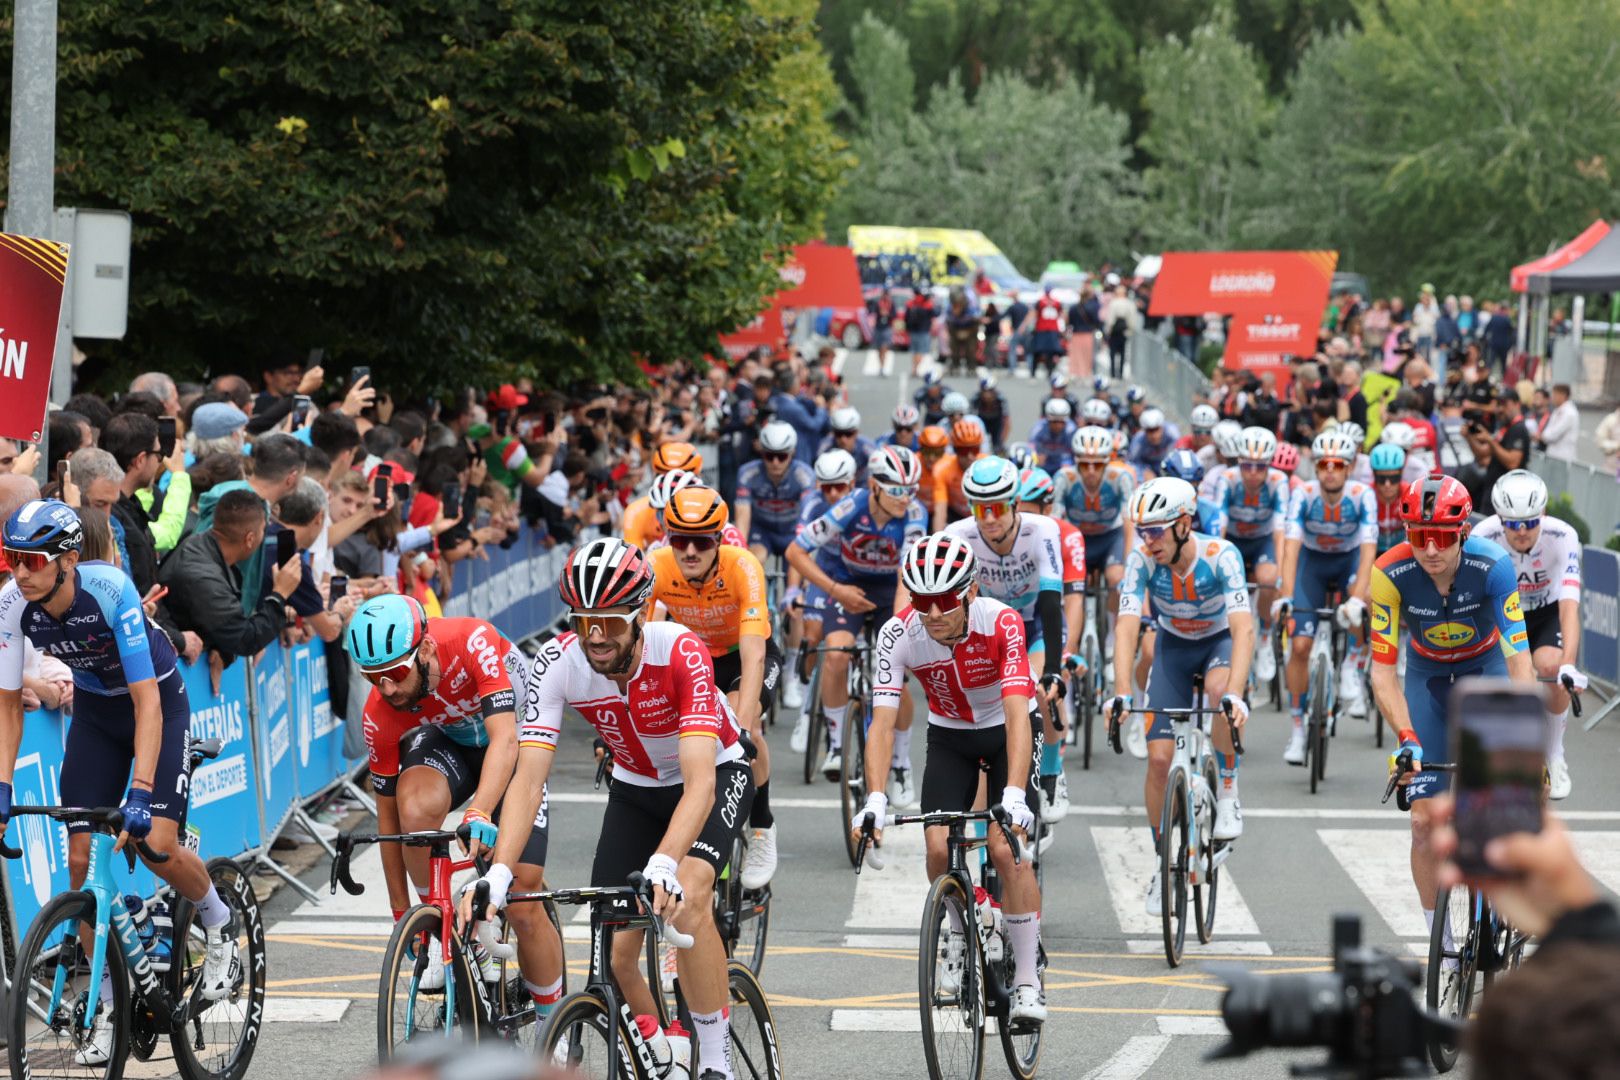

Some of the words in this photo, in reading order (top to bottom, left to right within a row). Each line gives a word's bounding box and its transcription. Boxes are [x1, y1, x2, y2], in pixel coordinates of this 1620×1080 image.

[979, 560, 1036, 577] AHRAIN
[1389, 561, 1416, 578] TREK
[1464, 559, 1490, 572] TREK
[1517, 570, 1548, 583] AE
[1408, 605, 1438, 617] Santini
[467, 625, 499, 678] lotto
[964, 658, 993, 667] mobel
[1000, 612, 1023, 677] Cofidis
[678, 637, 711, 713] Cofidis
[190, 695, 243, 742] OTERÍAS
[493, 699, 513, 708] lotto
[638, 695, 669, 710] mobel
[720, 771, 748, 828] Cofidis
[87, 839, 98, 880] FACTOR
[234, 871, 264, 973] BLACK
[593, 929, 601, 976] LOOK
[466, 944, 492, 1023] RBEA
[246, 987, 264, 1041] INC
